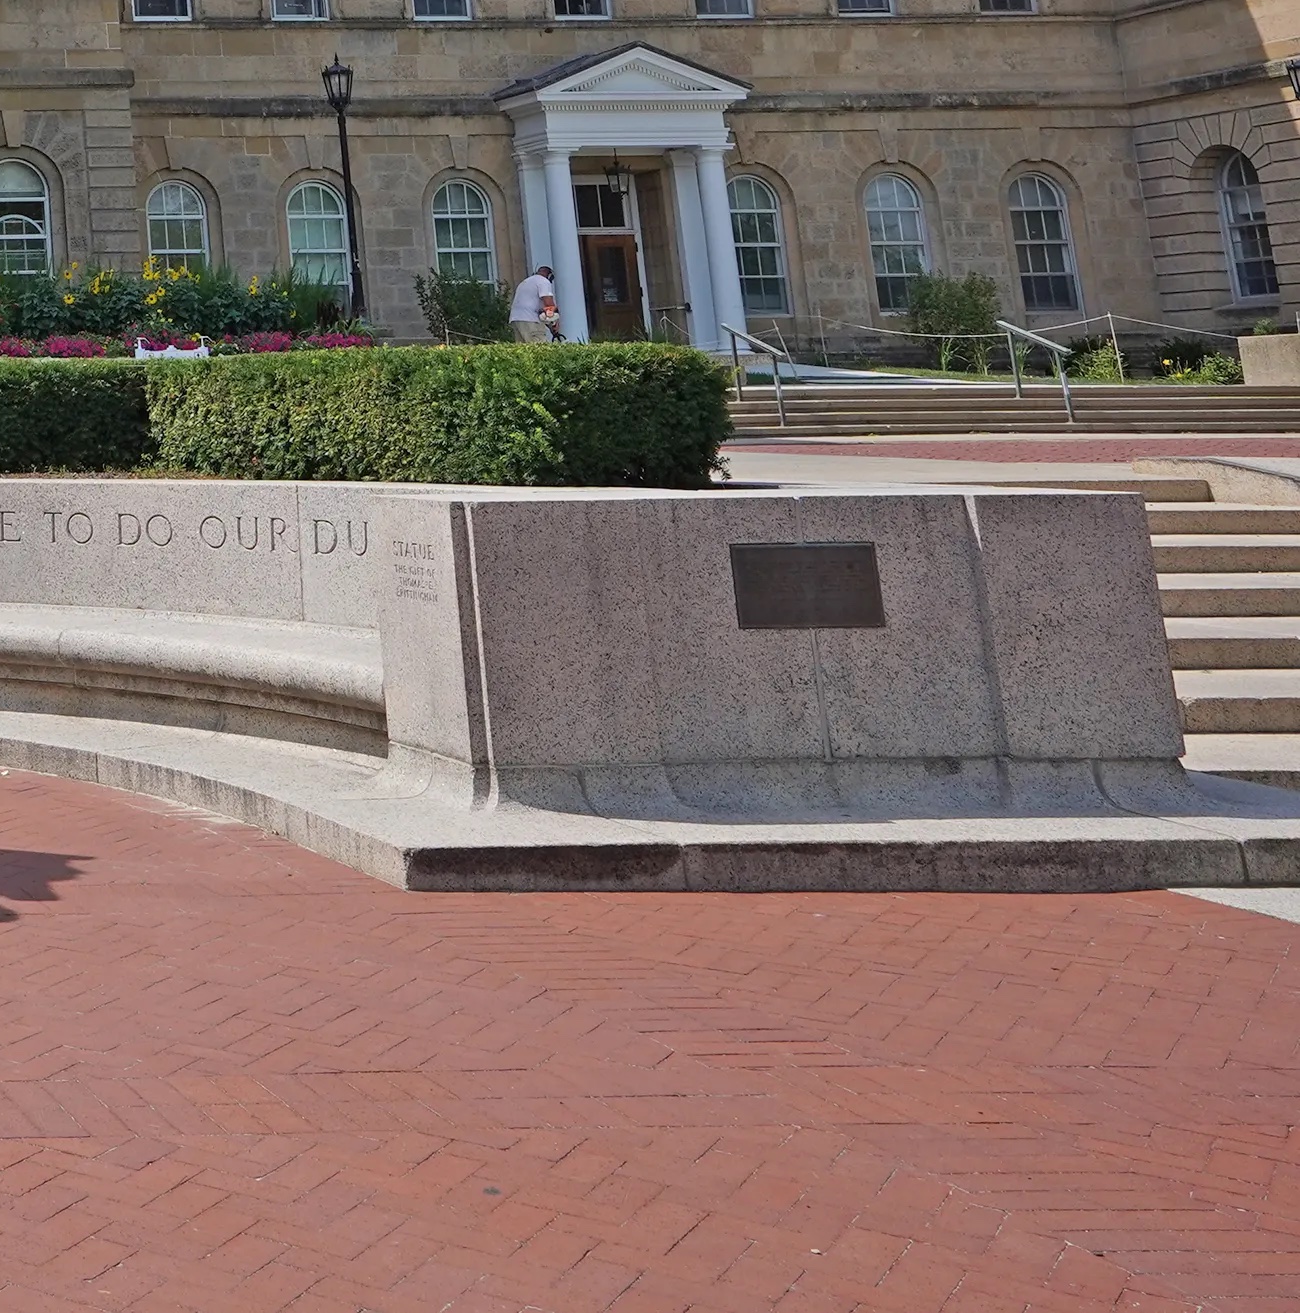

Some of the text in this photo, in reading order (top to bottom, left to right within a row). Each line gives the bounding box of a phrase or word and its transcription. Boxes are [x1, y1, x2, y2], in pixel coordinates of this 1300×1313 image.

[43, 511, 94, 545] TO
[116, 512, 174, 547] DO
[199, 515, 298, 554] OUR
[392, 540, 435, 561] STATUE
